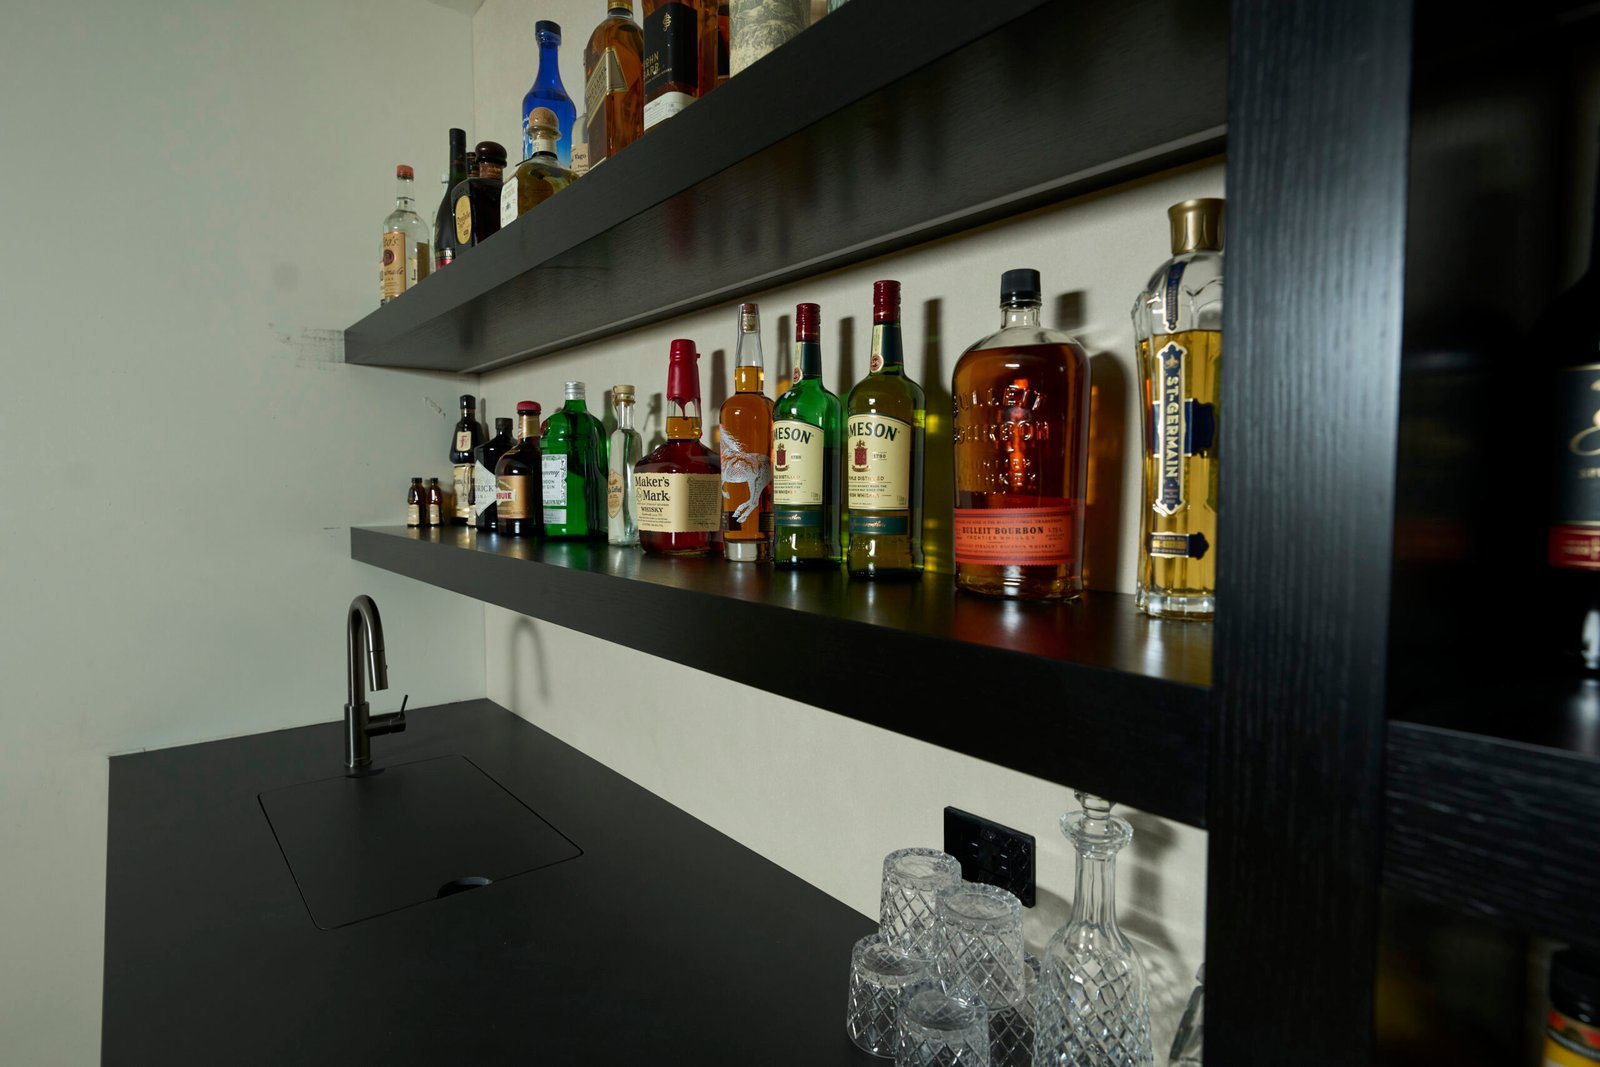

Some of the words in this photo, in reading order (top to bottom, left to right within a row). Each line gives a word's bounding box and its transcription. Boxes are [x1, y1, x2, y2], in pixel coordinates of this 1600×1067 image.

[848, 421, 898, 442] MESON
[1166, 376, 1180, 479] ST-GERMAIN
[635, 476, 670, 488] Maker's
[496, 492, 512, 500] BUIE
[643, 490, 670, 502] Mark
[962, 526, 992, 534] BULLEIT
[994, 526, 1045, 535] BOURBON
